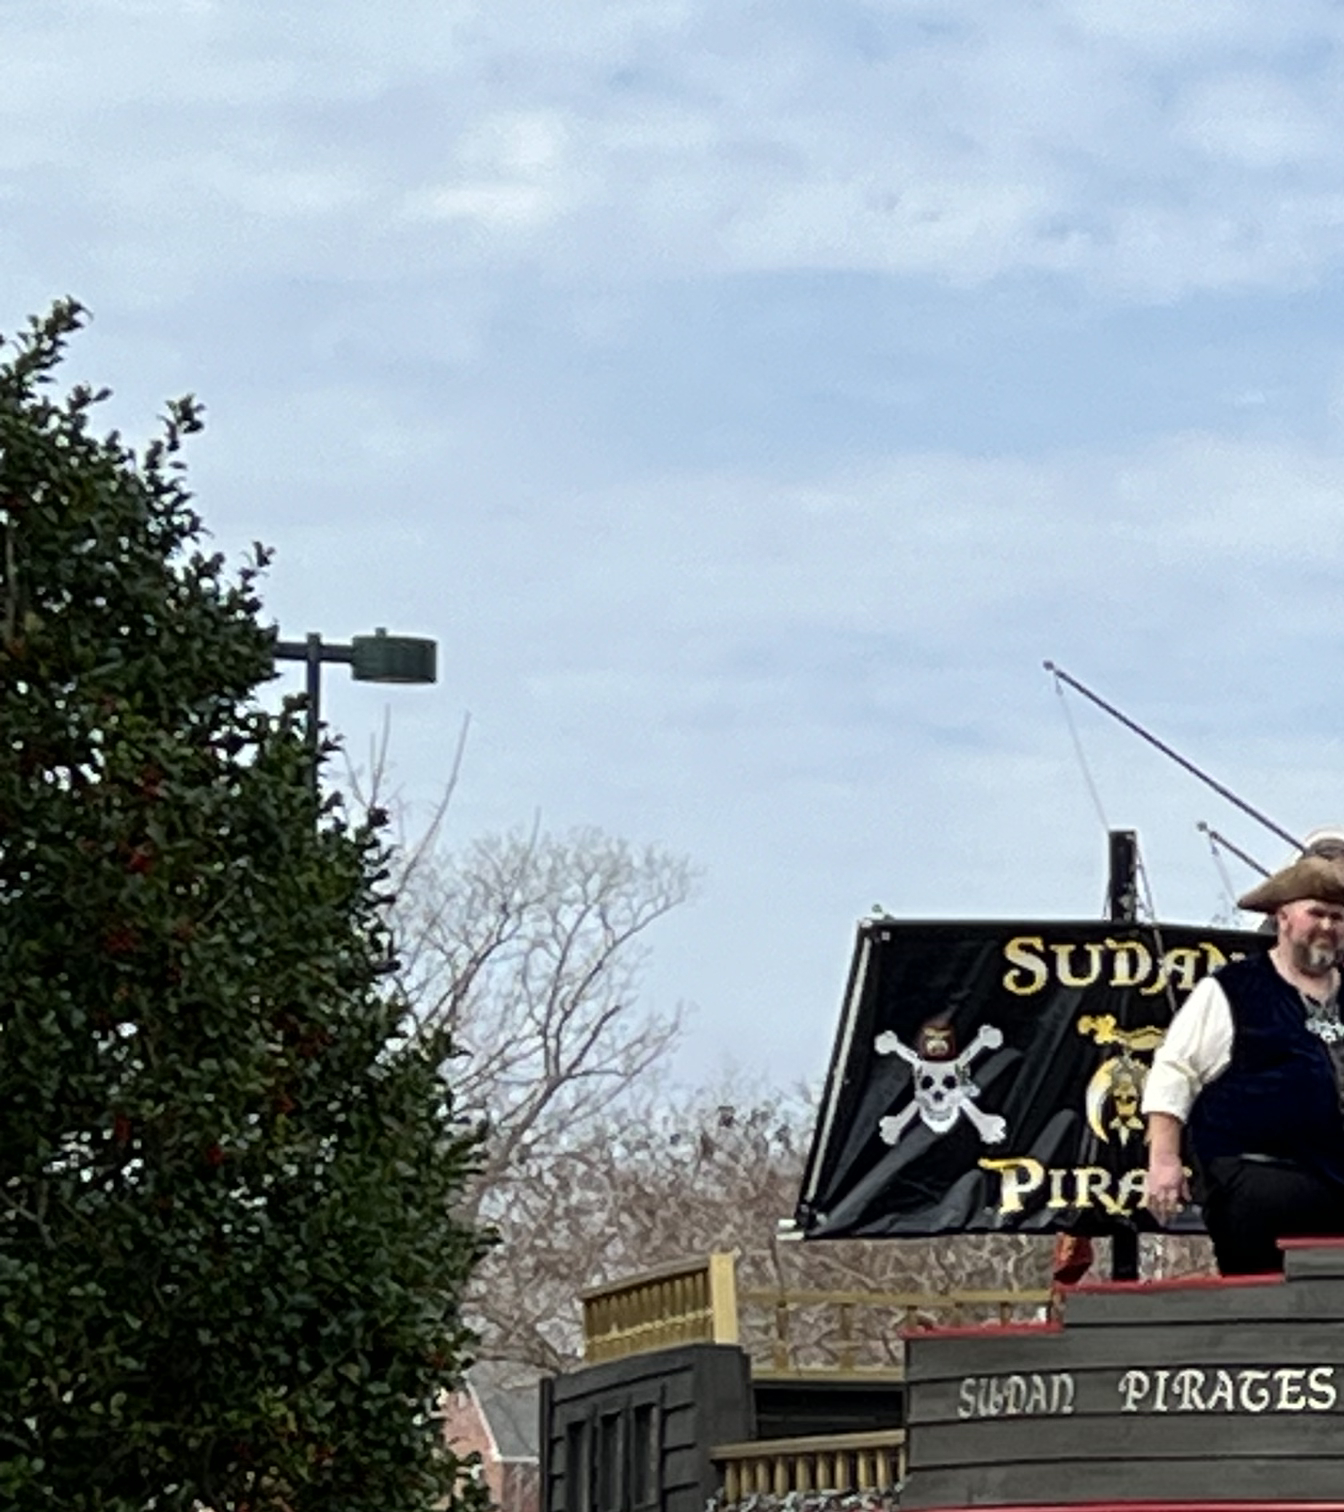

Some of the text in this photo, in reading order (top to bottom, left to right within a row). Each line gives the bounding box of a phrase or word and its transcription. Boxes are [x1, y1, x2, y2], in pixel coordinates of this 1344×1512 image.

[977, 1157, 1193, 1216] PIRA
[957, 1366, 1338, 1419] SUDAN PIRATES
